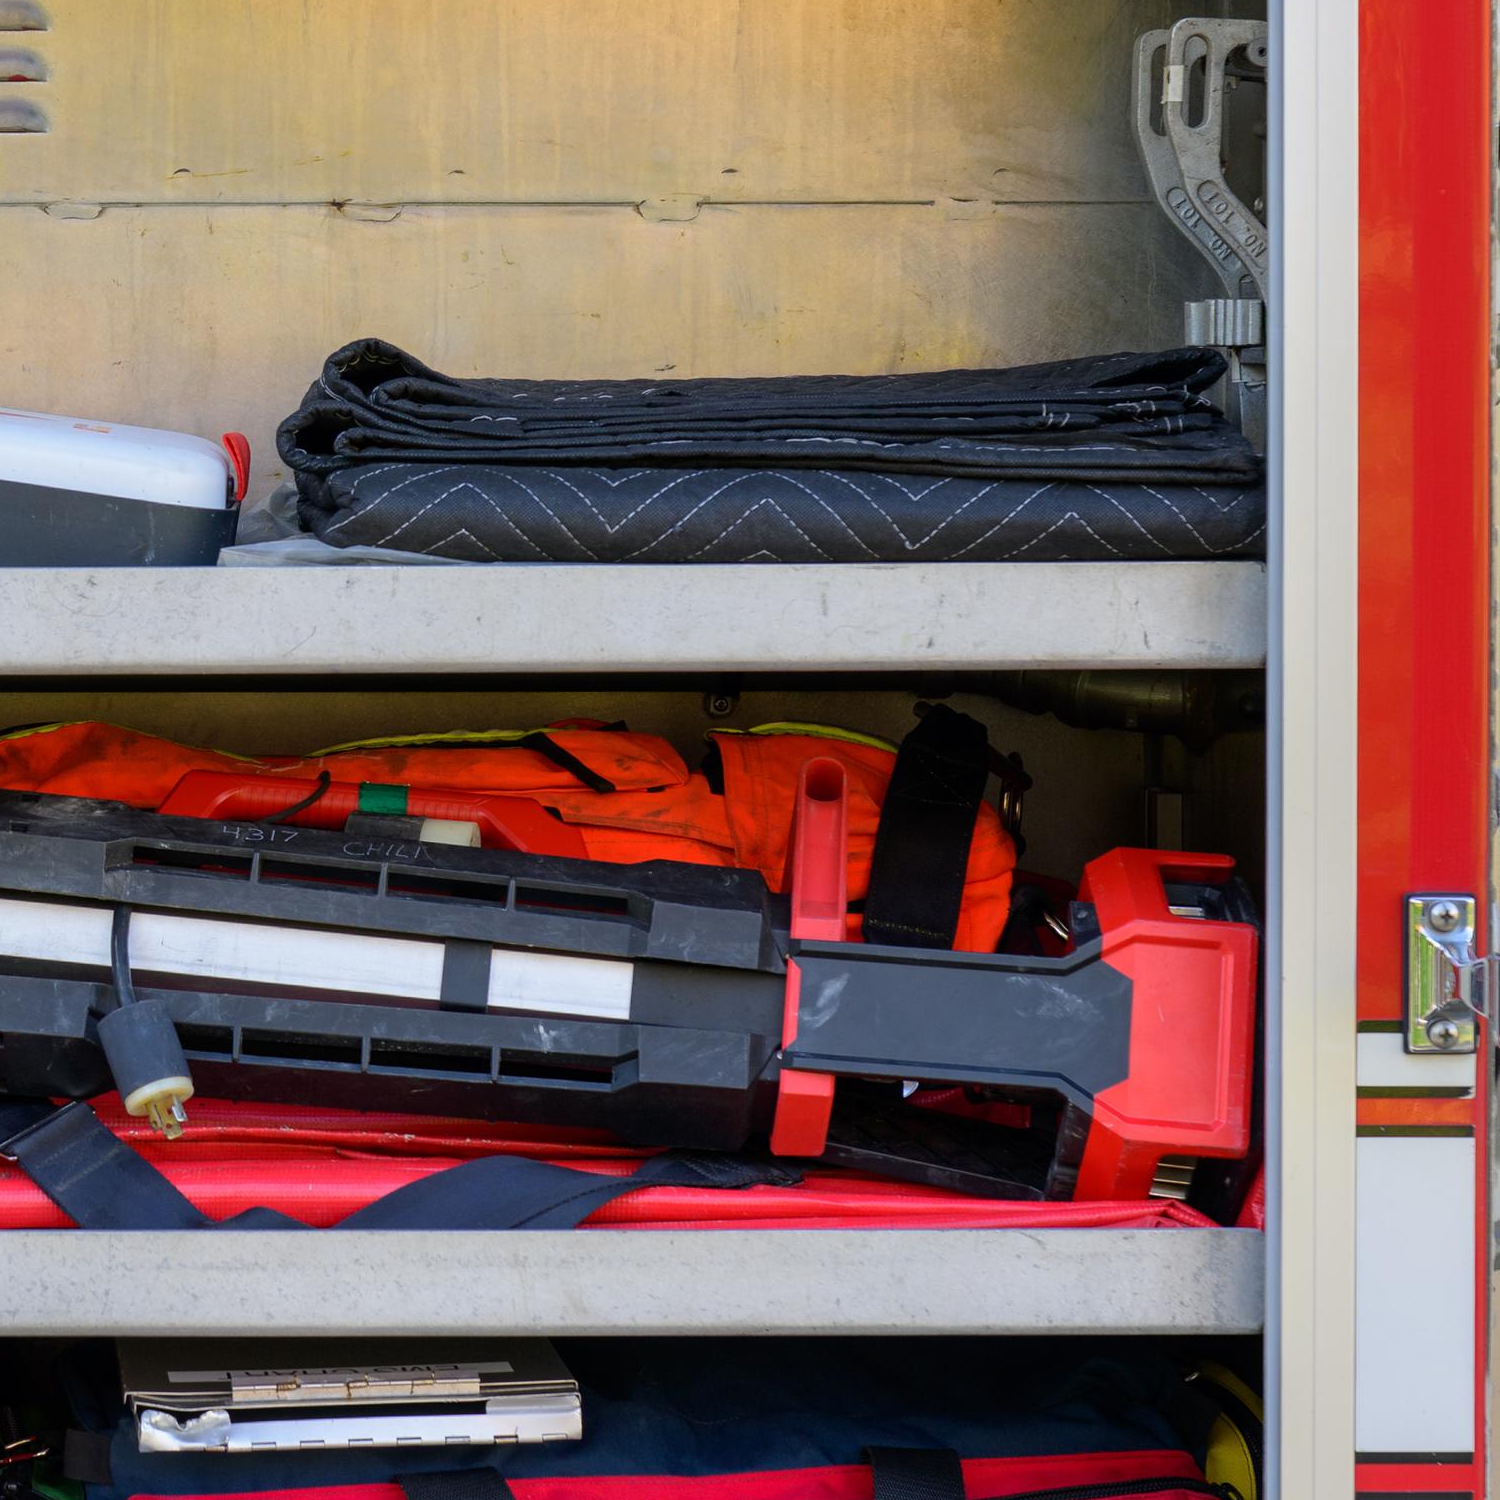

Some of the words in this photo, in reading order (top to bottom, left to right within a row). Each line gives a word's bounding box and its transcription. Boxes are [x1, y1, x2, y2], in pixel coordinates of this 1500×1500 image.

[1172, 198, 1200, 229] 101
[1206, 192, 1235, 223] 101
[223, 826, 298, 842] 4317
